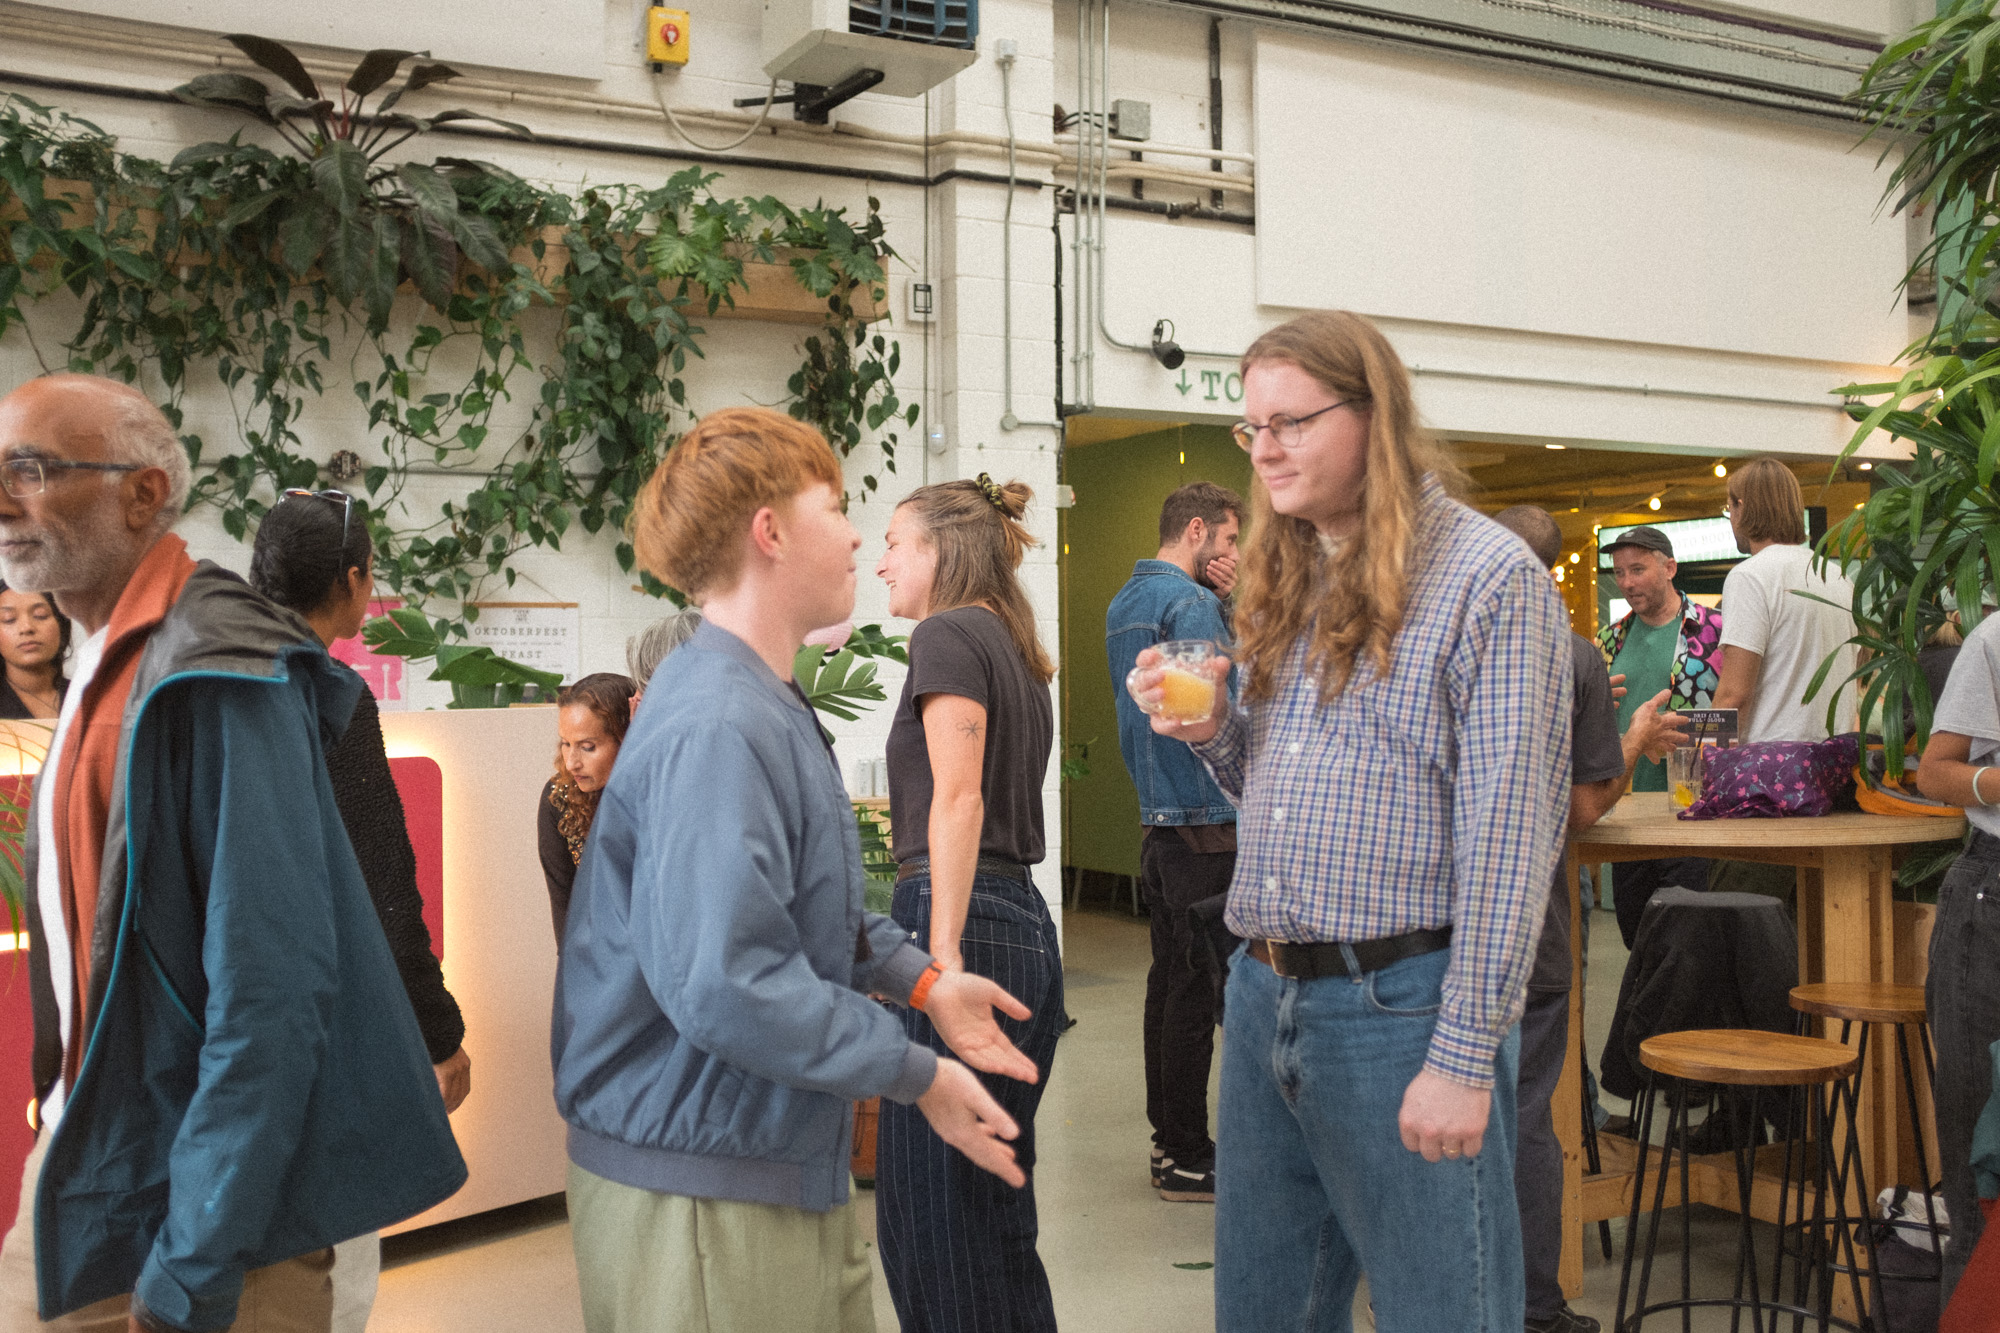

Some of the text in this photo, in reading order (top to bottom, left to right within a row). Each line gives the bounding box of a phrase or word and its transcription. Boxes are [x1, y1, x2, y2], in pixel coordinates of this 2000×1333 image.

[1674, 530, 1732, 550] OTO BOOT
[474, 627, 567, 636] OKTOBERFEST
